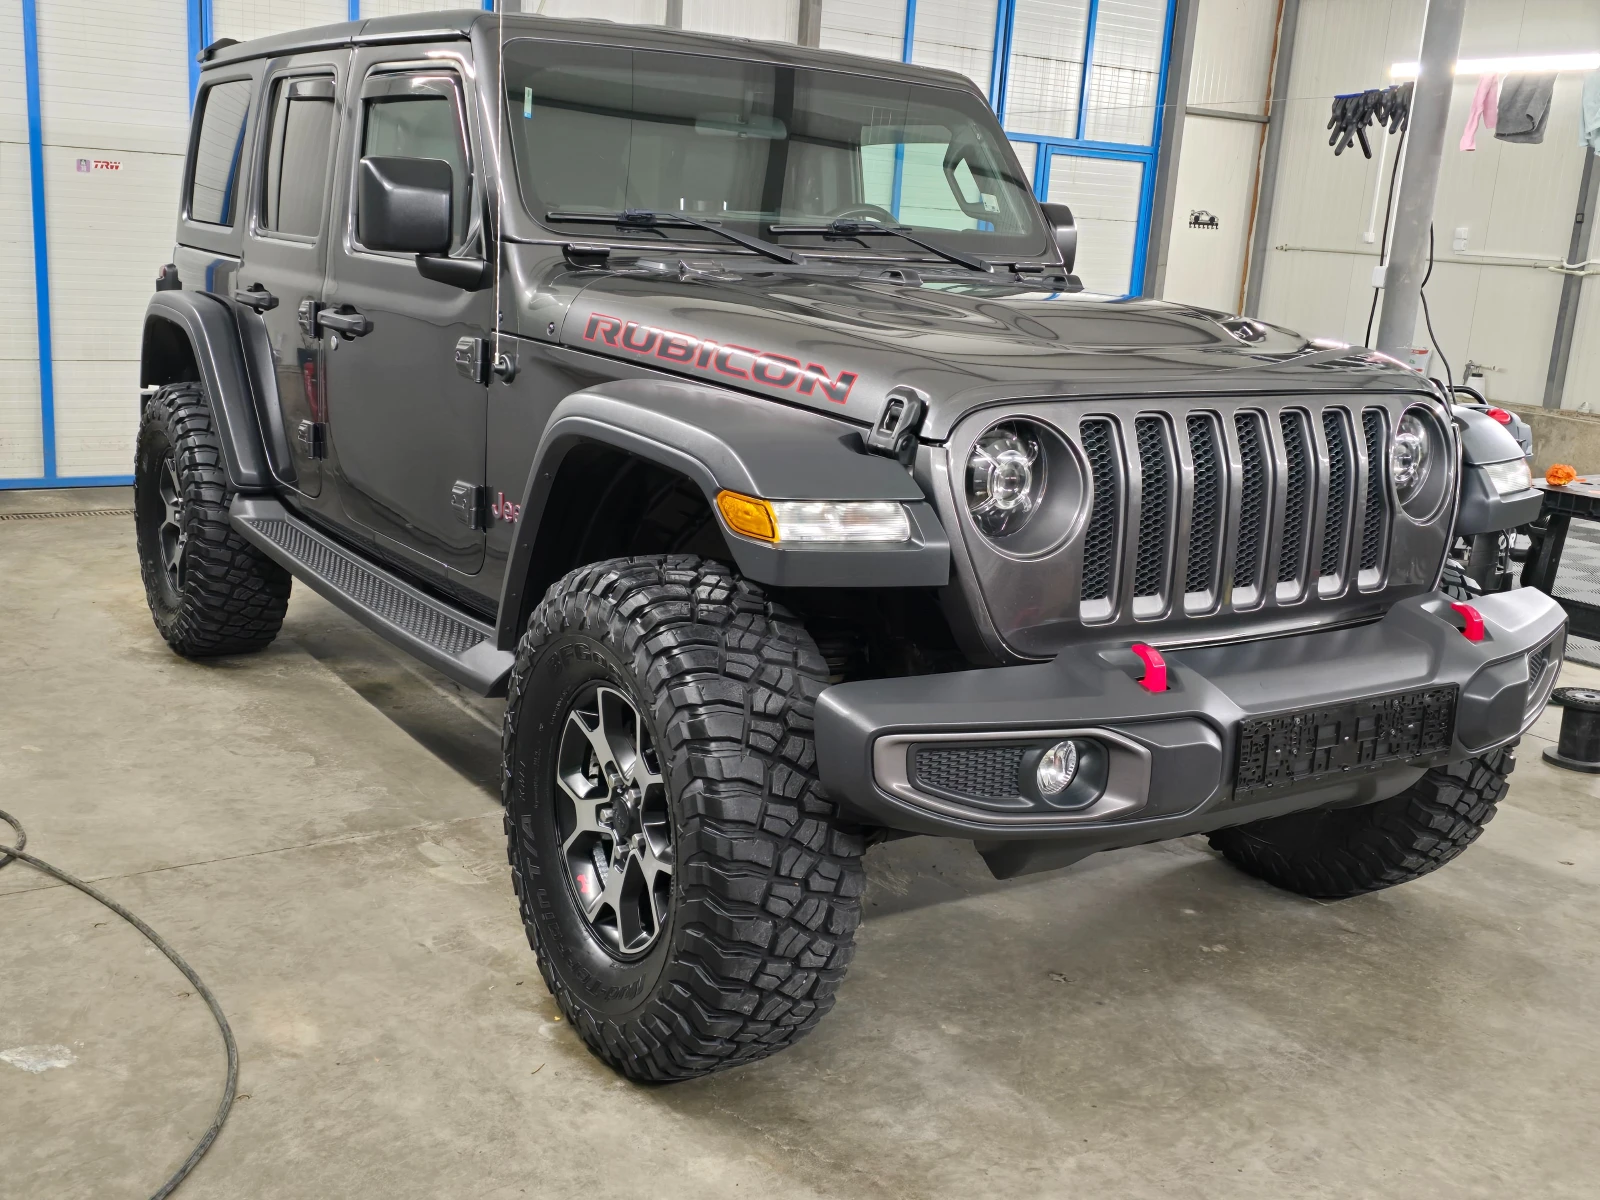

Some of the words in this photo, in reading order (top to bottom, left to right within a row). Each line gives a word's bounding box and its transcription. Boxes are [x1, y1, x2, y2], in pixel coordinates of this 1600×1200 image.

[93, 160, 121, 170] TRW
[582, 312, 859, 405] RUBICON
[491, 491, 521, 523] Jee
